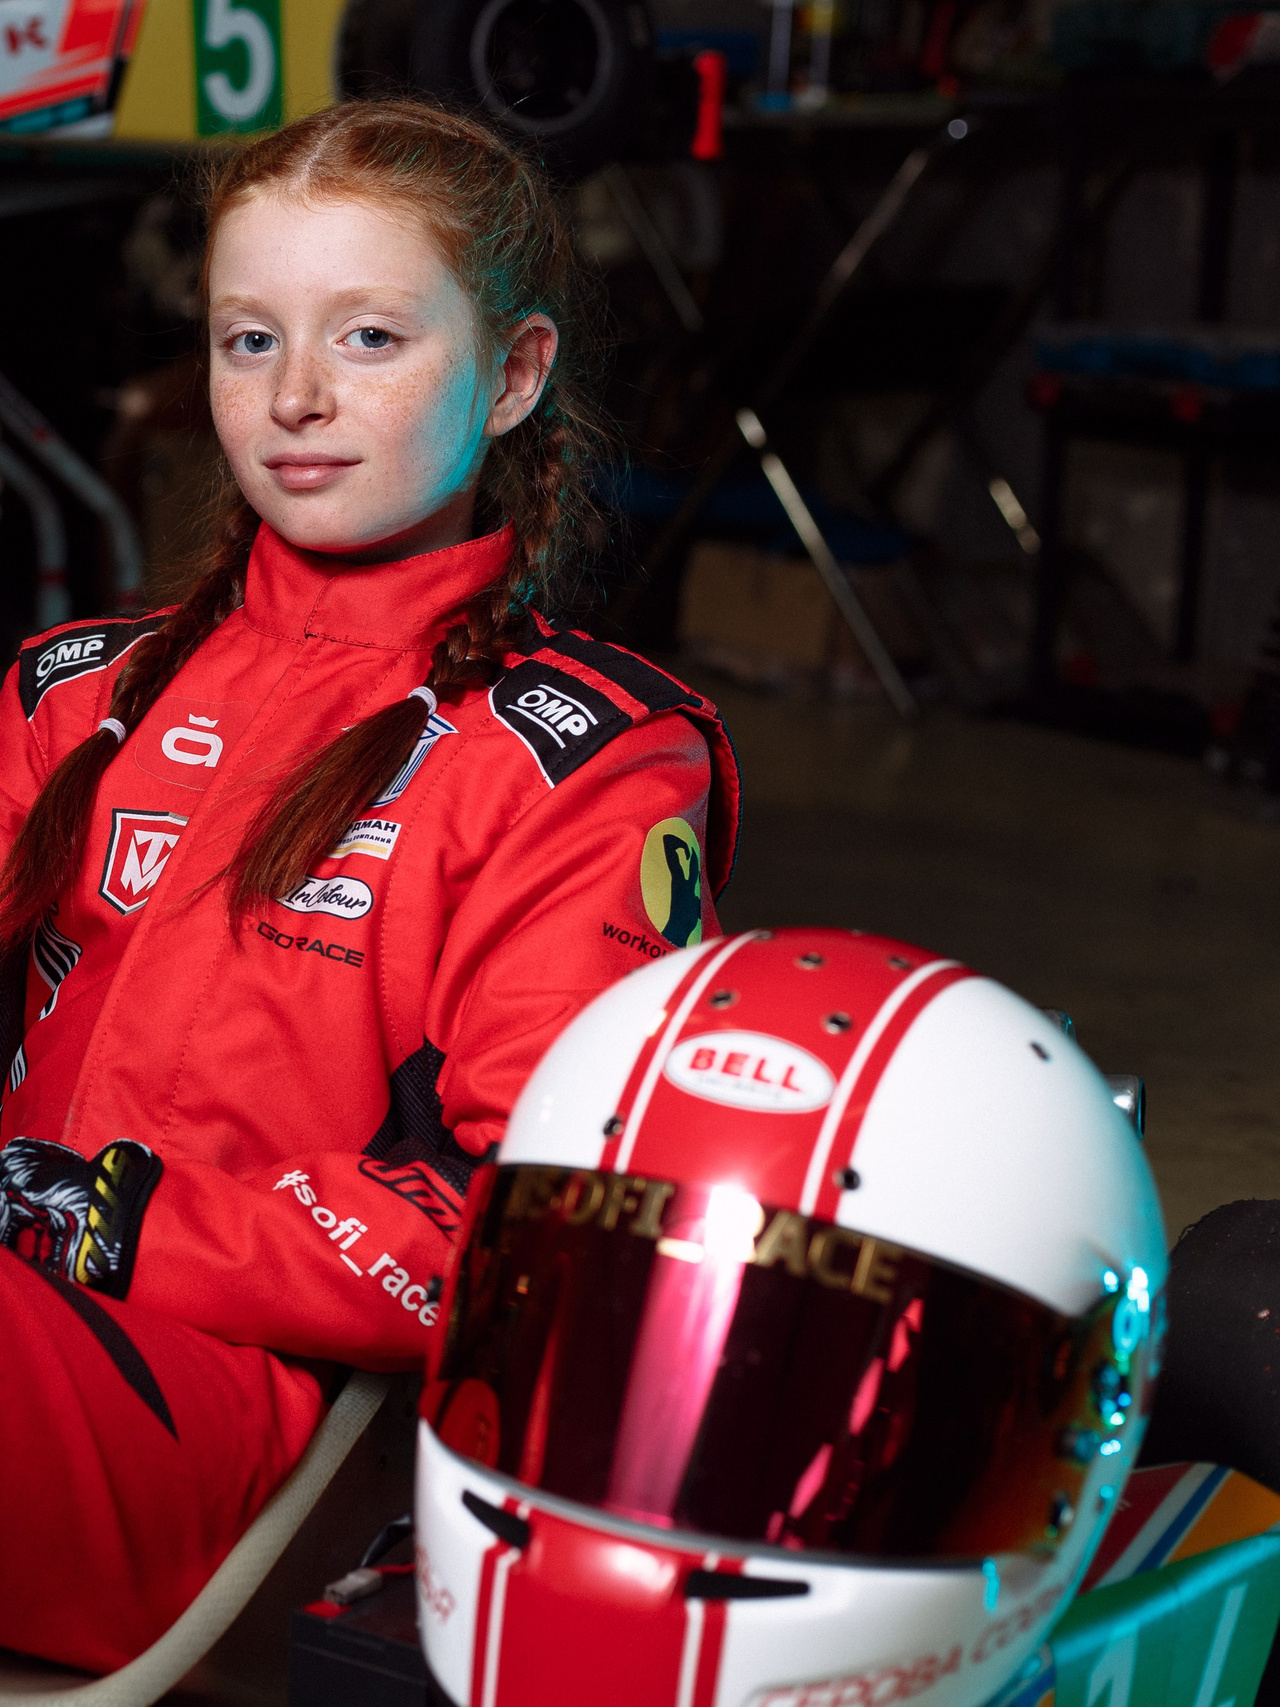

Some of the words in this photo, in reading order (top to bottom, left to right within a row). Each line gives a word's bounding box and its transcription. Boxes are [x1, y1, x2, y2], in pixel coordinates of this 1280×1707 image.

[205, 0, 276, 118] 5
[36, 638, 105, 678] OMP
[517, 689, 589, 737] OMP
[257, 921, 365, 968] GORACE
[689, 1047, 802, 1093] BELL
